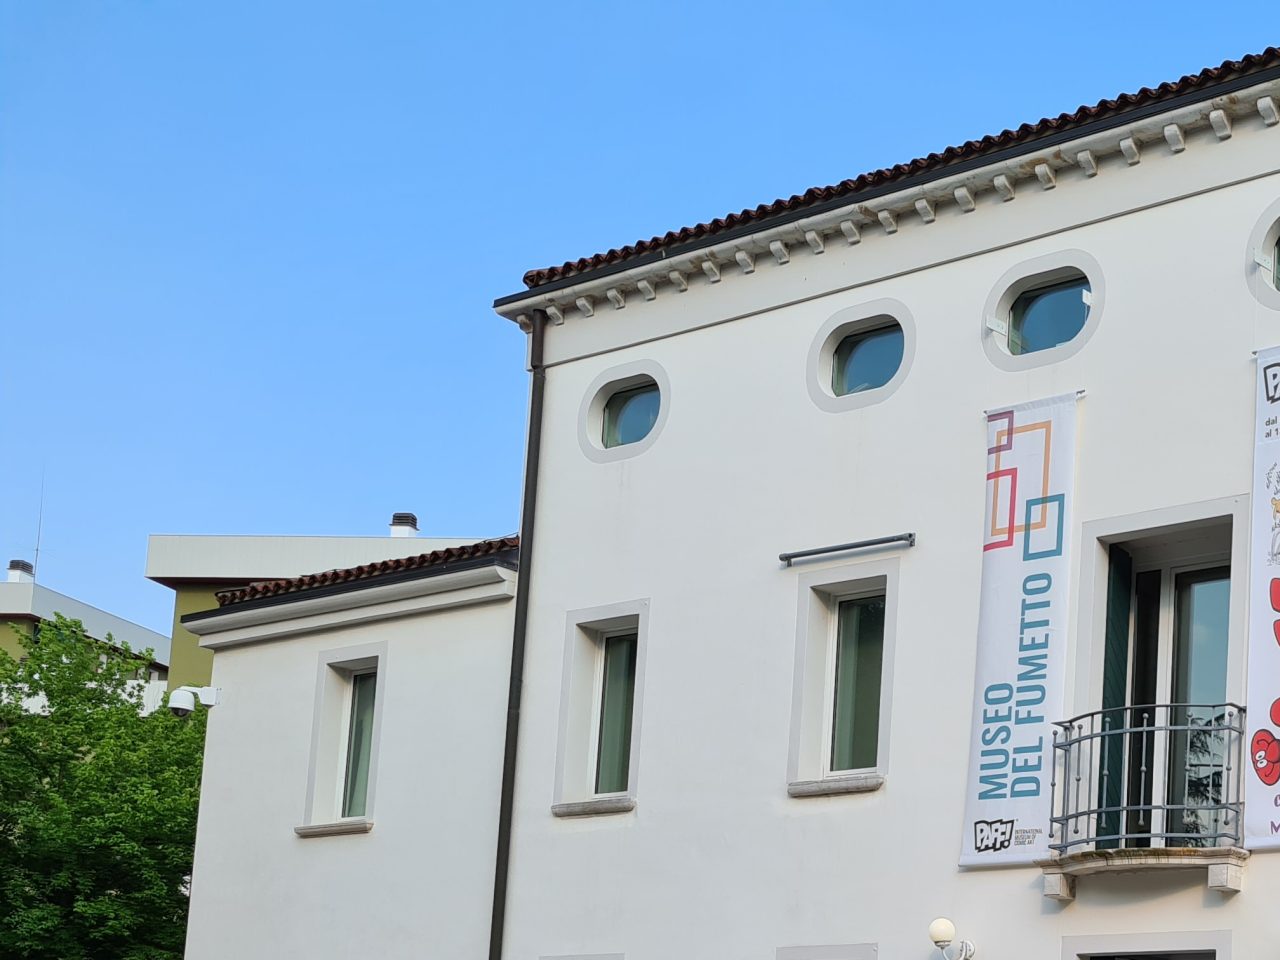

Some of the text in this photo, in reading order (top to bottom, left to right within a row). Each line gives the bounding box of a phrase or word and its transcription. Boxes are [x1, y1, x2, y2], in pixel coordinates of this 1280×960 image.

[1264, 429, 1272, 438] al
[1265, 416, 1278, 426] dal
[1010, 572, 1053, 798] DEL FUMETTO
[978, 682, 1014, 801] MUSEO
[974, 819, 1014, 852] PAFF!
